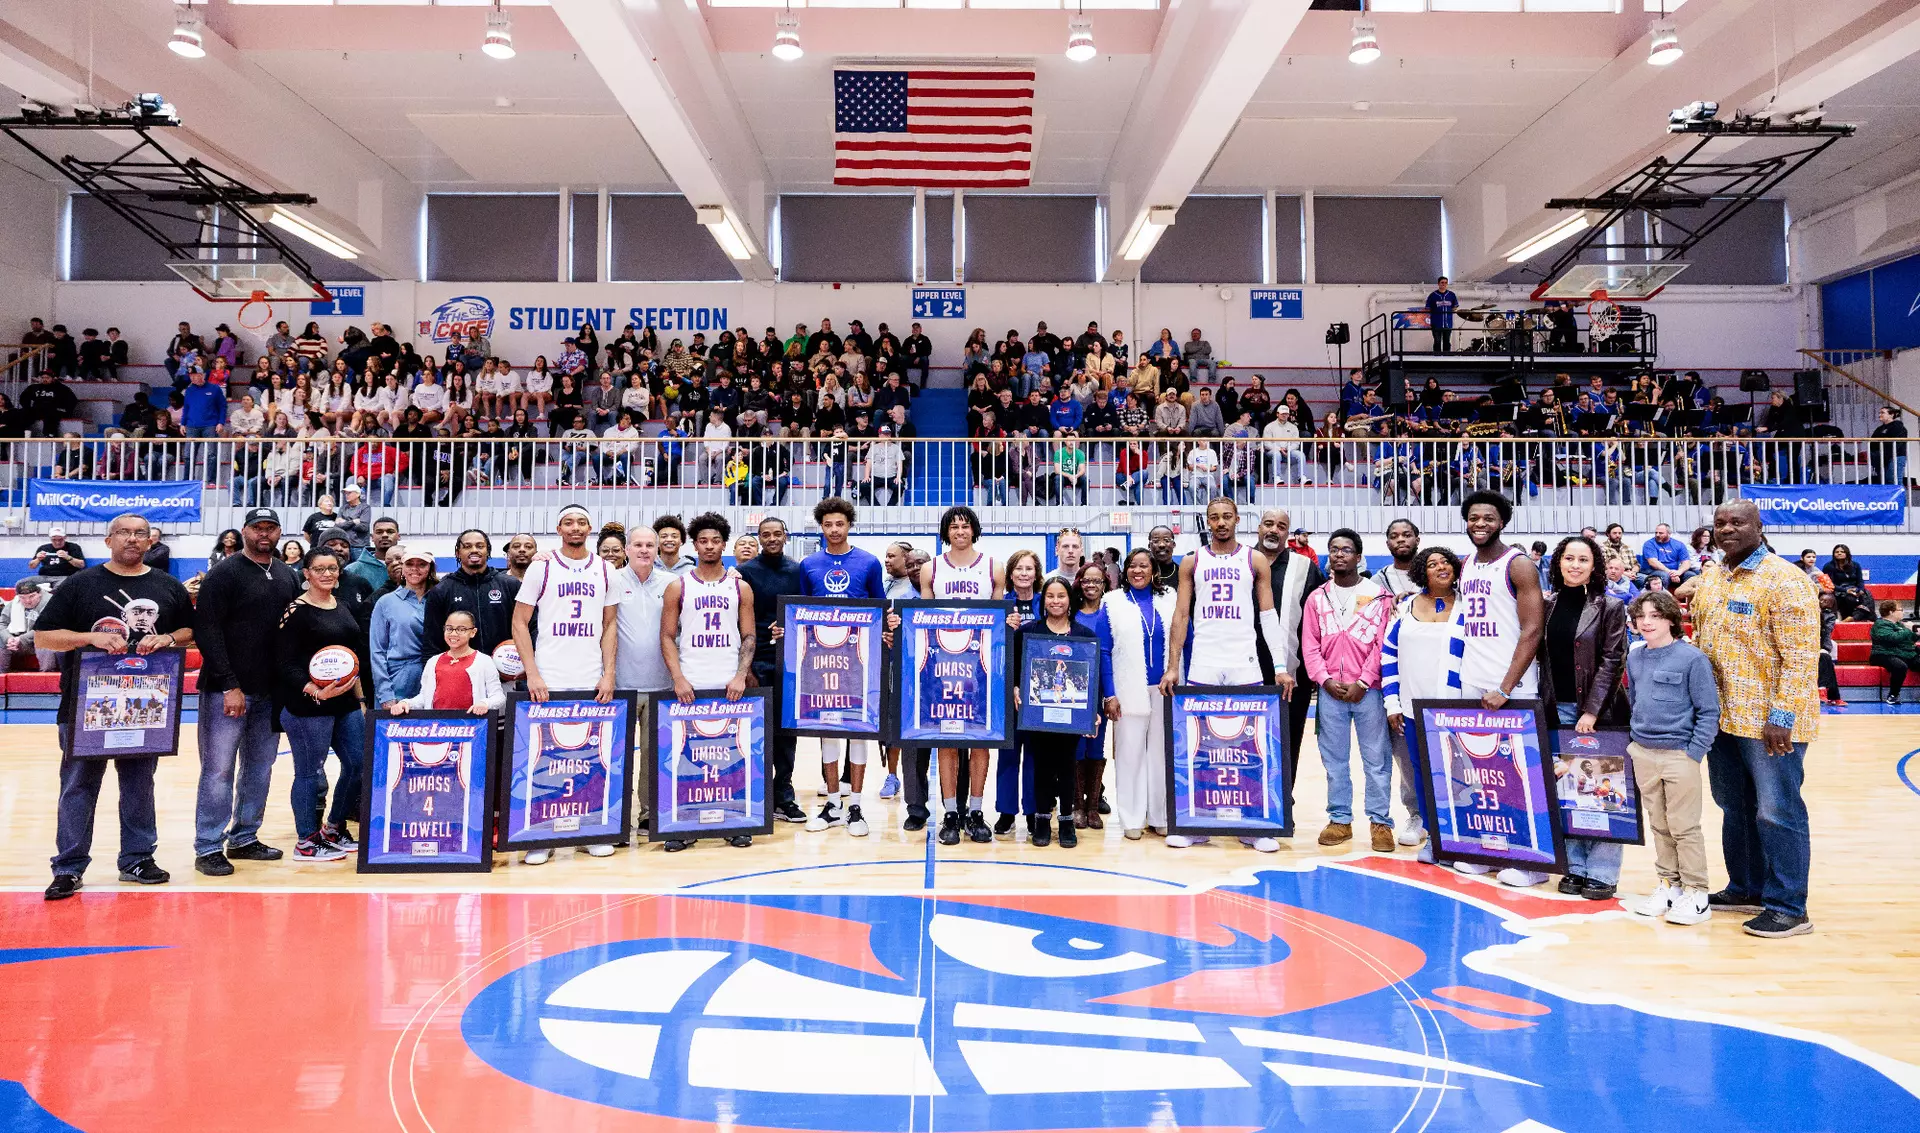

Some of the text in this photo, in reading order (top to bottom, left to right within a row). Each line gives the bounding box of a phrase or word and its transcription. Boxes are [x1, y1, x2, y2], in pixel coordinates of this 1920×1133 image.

[340, 289, 361, 297] LEVEL
[915, 292, 962, 300] UPPER LEVEL
[1253, 292, 1300, 300] UPPER LEVEL
[332, 298, 342, 314] 1
[924, 301, 952, 316] 1 2
[1272, 301, 1282, 317] 2
[445, 312, 468, 322] THE
[510, 307, 728, 330] STUDENT SECTION
[437, 320, 488, 337] CAGE
[36, 493, 194, 509] MillCityCollective.com
[1112, 512, 1128, 524] EXIT
[1204, 567, 1240, 582] UMASS
[558, 582, 595, 597] UMASS
[945, 580, 978, 594] UMASS
[1212, 584, 1233, 601] 23
[570, 600, 582, 618] 3
[694, 595, 729, 610] UMASS
[1468, 597, 1486, 617] 33
[796, 608, 872, 622] UMASS LOWELL
[912, 610, 994, 624] UMASS LOWELL
[1203, 606, 1241, 619] LOWELL
[553, 622, 594, 636] LOWELL
[704, 612, 721, 630] 14
[1464, 622, 1498, 637] OWELL
[692, 634, 731, 647] LOWELL
[814, 655, 849, 670] UMASS
[935, 661, 972, 678] UMASS
[822, 672, 839, 690] 10
[943, 680, 964, 700] 24
[670, 702, 754, 716] UMASS LOWELL
[811, 694, 852, 708] LOWELL
[1184, 698, 1268, 712] UMASS LOWELL
[528, 704, 617, 718] UMASS LOWELL
[931, 704, 974, 720] LOWELL
[1434, 712, 1524, 728] UMASS LOWELL
[387, 723, 475, 737] UMASS LOWELL
[691, 746, 730, 762] UMASS
[1209, 748, 1248, 764] UMASS
[548, 759, 590, 776] UMASS
[701, 764, 719, 783] 14
[408, 775, 450, 793] UMASS
[1217, 766, 1239, 786] 23
[1464, 768, 1506, 787] UMASS
[563, 778, 574, 797] 3
[688, 787, 734, 803] LOWELL
[1206, 790, 1252, 805] LOWELL
[1475, 788, 1500, 810] 33
[423, 796, 433, 816] 4
[542, 801, 590, 818] LOWELL
[402, 821, 452, 838] LOWELL
[1466, 813, 1517, 834] LOWELL
